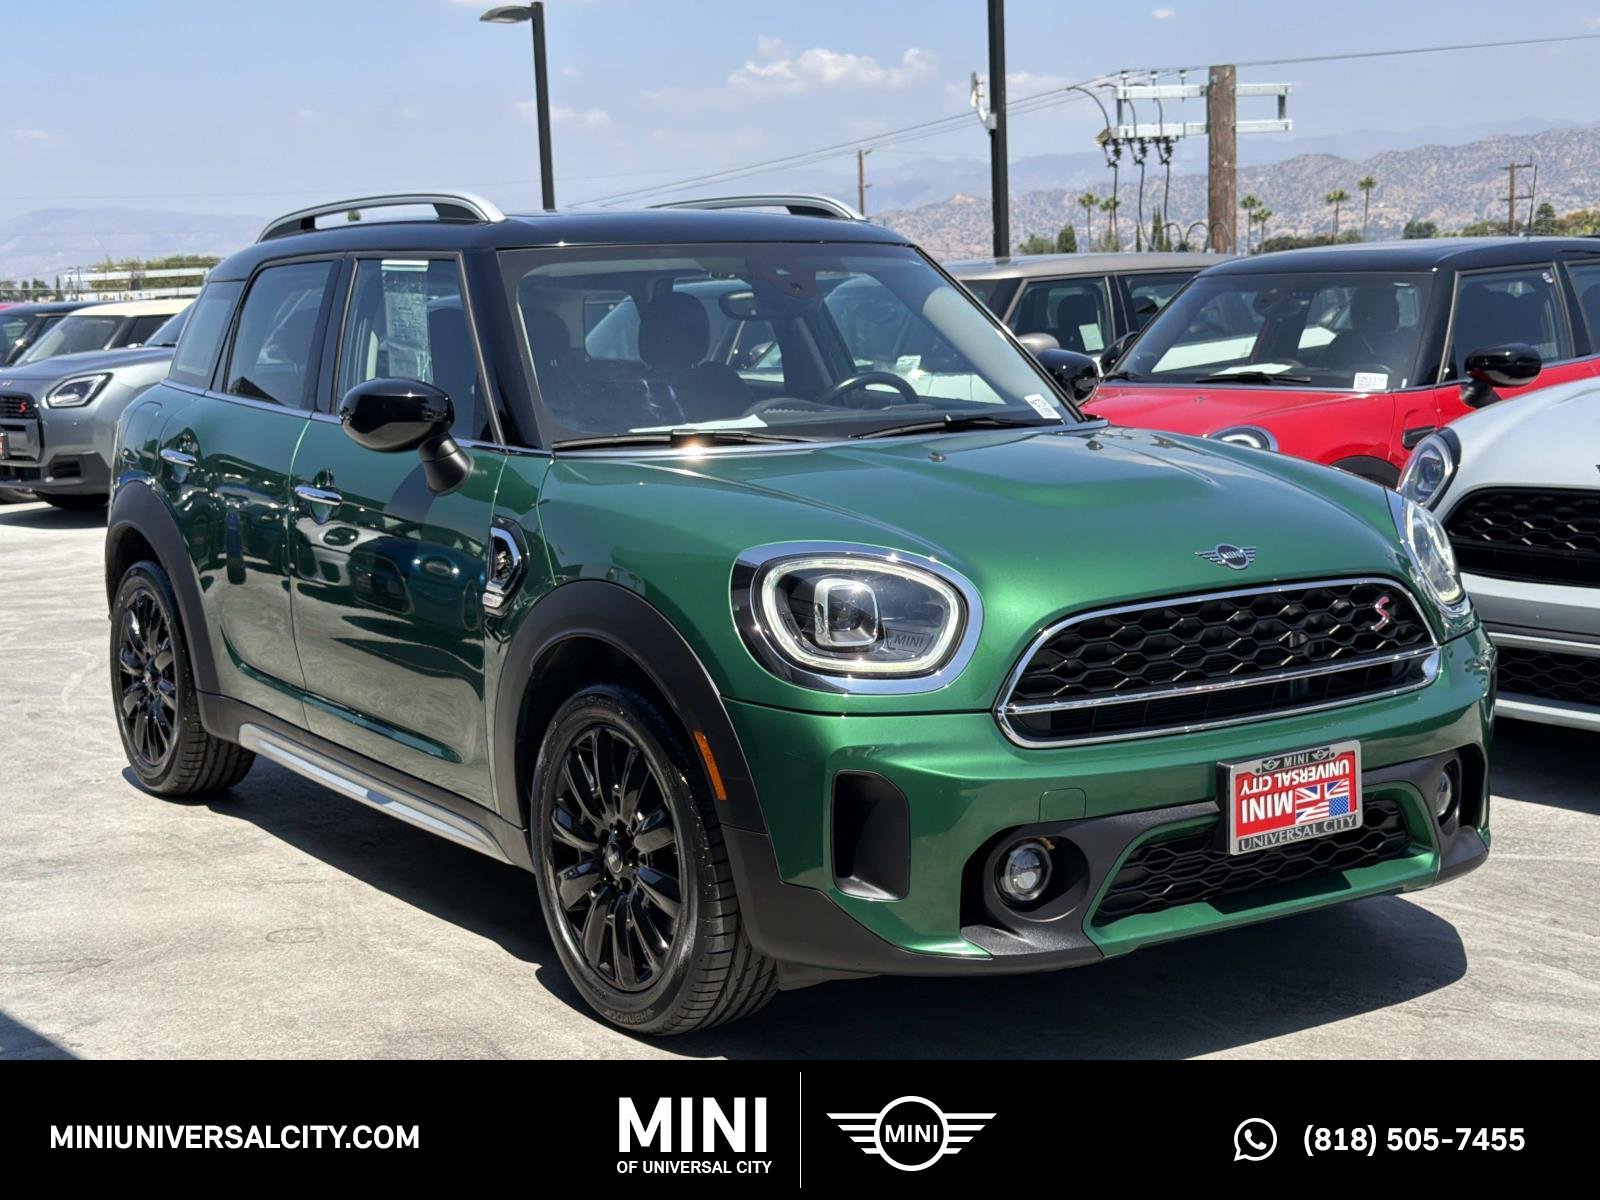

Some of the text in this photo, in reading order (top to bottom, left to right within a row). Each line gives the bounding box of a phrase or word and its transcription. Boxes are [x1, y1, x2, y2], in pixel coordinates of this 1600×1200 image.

[1371, 596, 1389, 632] S
[895, 634, 924, 647] MINI
[1240, 759, 1349, 796] UNIVERSAL CITY
[1284, 752, 1309, 768] MINI
[1242, 789, 1294, 824] MINI
[1241, 816, 1355, 851] UNIVERSAL CITY
